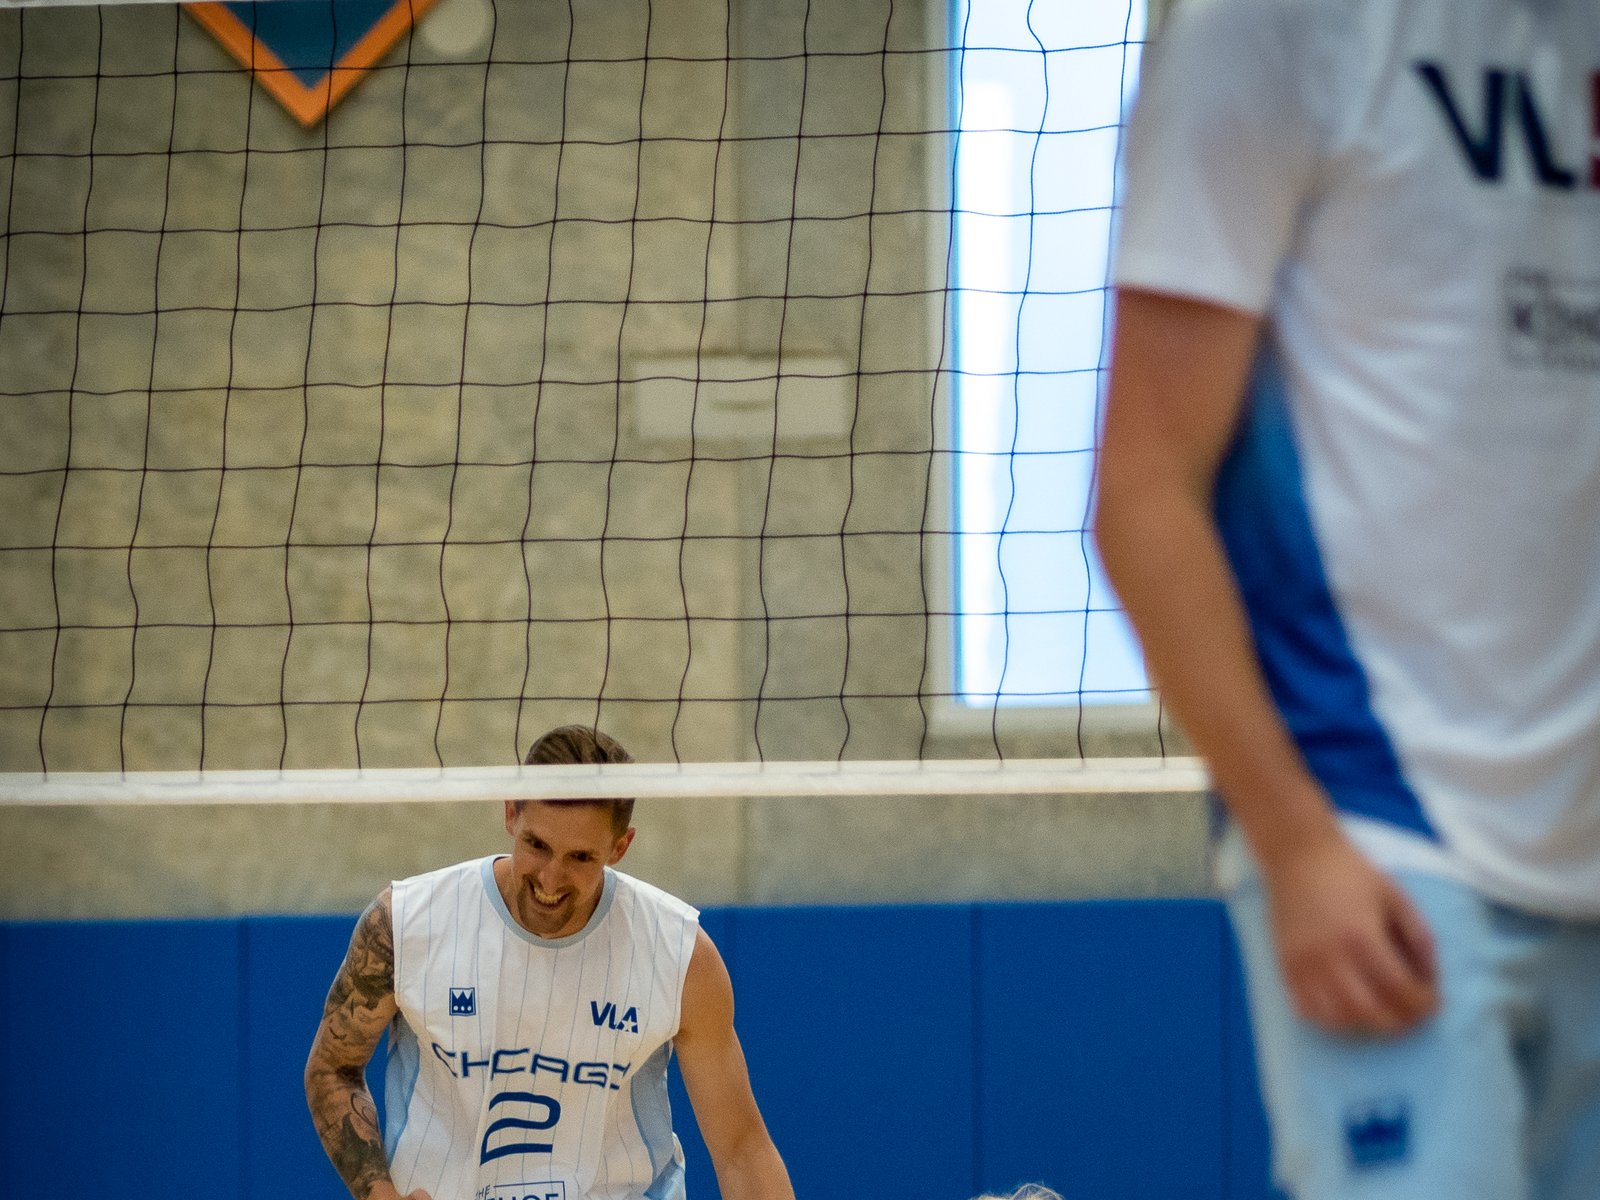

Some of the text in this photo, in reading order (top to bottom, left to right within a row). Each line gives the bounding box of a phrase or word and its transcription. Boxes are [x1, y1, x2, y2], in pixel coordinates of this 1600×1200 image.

[1413, 60, 1600, 186] VL
[591, 1001, 638, 1033] VLA
[432, 1043, 631, 1090] CHCAG
[480, 1092, 561, 1165] 2
[475, 1184, 491, 1199] HE
